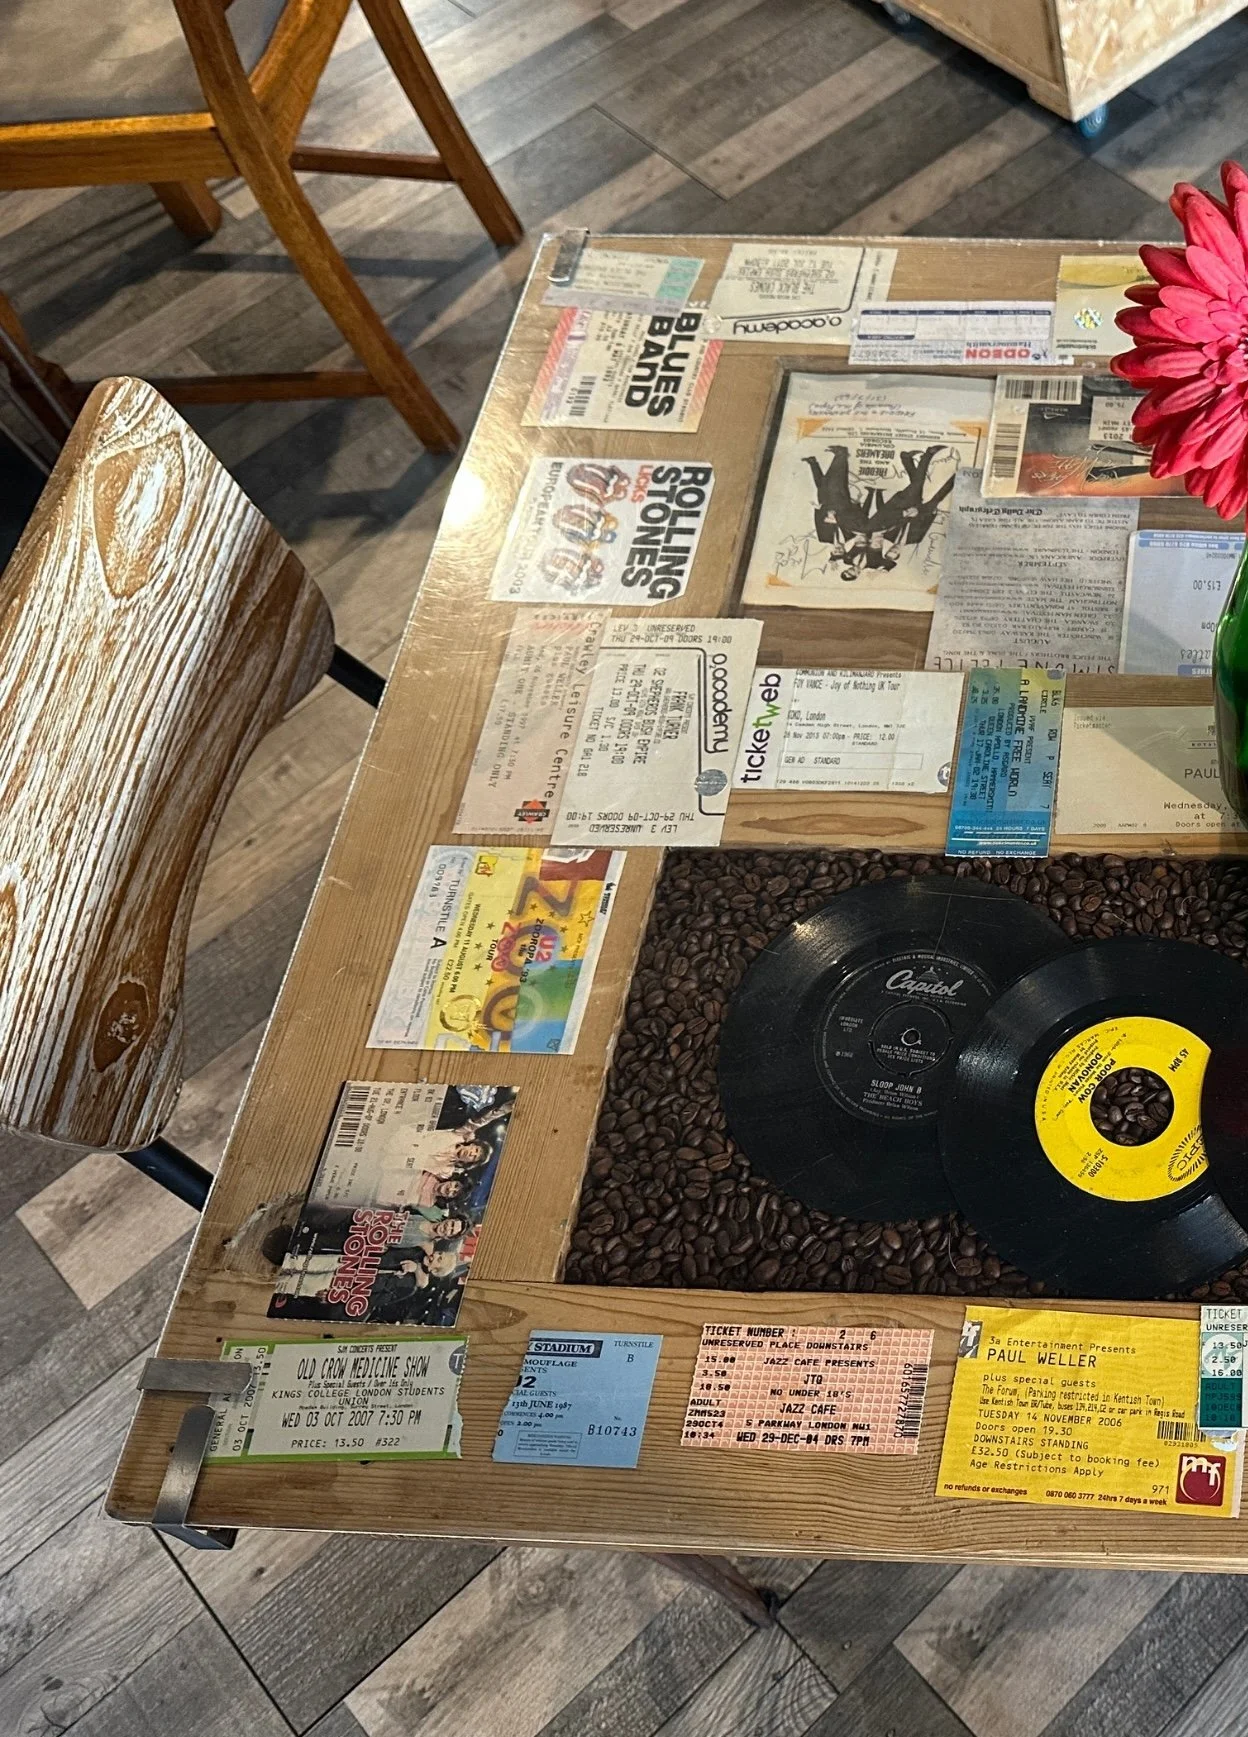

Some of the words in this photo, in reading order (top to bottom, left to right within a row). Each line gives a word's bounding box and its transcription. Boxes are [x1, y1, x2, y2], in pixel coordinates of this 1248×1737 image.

[966, 350, 1030, 359] ODEON
[647, 313, 703, 417] BLUES
[856, 449, 895, 459] DREAMERS
[632, 465, 654, 503] LICKS
[621, 465, 682, 588] STONES
[648, 466, 713, 600] ROLLING
[1193, 580, 1221, 590] £15.00
[648, 624, 695, 632] UNRESERVED
[576, 622, 602, 674] Crawley
[561, 682, 585, 739] Leisure
[741, 673, 781, 784] ticketweb
[1012, 740, 1022, 762] FREE
[545, 748, 568, 798] Centre
[1008, 767, 1020, 797] WORLD
[1164, 802, 1227, 811] Wednesday,
[436, 879, 460, 933] TURNSTILE
[431, 937, 447, 949] A
[486, 939, 498, 962] TOUR
[525, 918, 545, 966] ZOOROPA
[535, 935, 558, 964] U2
[886, 969, 964, 997] Capitol
[1179, 1048, 1190, 1058] 45
[1068, 1053, 1103, 1093] DONOVAN
[1094, 1058, 1116, 1083] POOR
[1168, 1057, 1183, 1072] RPM
[871, 1079, 894, 1090] SLOOP
[895, 1082, 914, 1093] JOHN
[1078, 1083, 1096, 1104] COW
[387, 1211, 410, 1245] THE
[328, 1209, 373, 1304] STONES
[346, 1210, 396, 1317] ROLLING
[534, 1343, 593, 1354] STADIUM
[614, 1341, 654, 1349] TURNSTILE
[1007, 1338, 1083, 1351] Entertainment
[1089, 1343, 1136, 1355] Presents
[297, 1358, 317, 1380] OLD
[321, 1357, 349, 1379] CROW
[350, 1356, 402, 1379] MEDICINE
[404, 1356, 431, 1378] SHOW
[627, 1354, 634, 1363] B
[987, 1349, 1026, 1364] PAUL
[1037, 1353, 1097, 1368] WELLER
[804, 1375, 823, 1385] JTQ
[512, 1400, 528, 1408] 13th
[529, 1401, 553, 1409] JUNE
[555, 1401, 572, 1411] 1987
[780, 1404, 805, 1414] JAZZ
[811, 1405, 836, 1415] CAFE
[282, 1413, 301, 1428] WED
[306, 1412, 319, 1427] 03
[324, 1412, 344, 1427] OCT
[348, 1411, 374, 1427] 2007
[378, 1411, 404, 1426] 7:30
[408, 1410, 422, 1425] PM
[978, 1410, 1021, 1420] TUESDAY
[1027, 1412, 1037, 1421] 14
[1044, 1414, 1092, 1425] NOVEMBER
[1098, 1417, 1123, 1427] 2006
[588, 1424, 637, 1437] B10743
[737, 1432, 756, 1442] WED
[762, 1432, 819, 1445] 29-DEC-04
[825, 1434, 844, 1445] DRS
[850, 1435, 870, 1446] 7PM
[974, 1434, 1035, 1446] DOWNSTAIRS
[1041, 1438, 1089, 1450] STANDING
